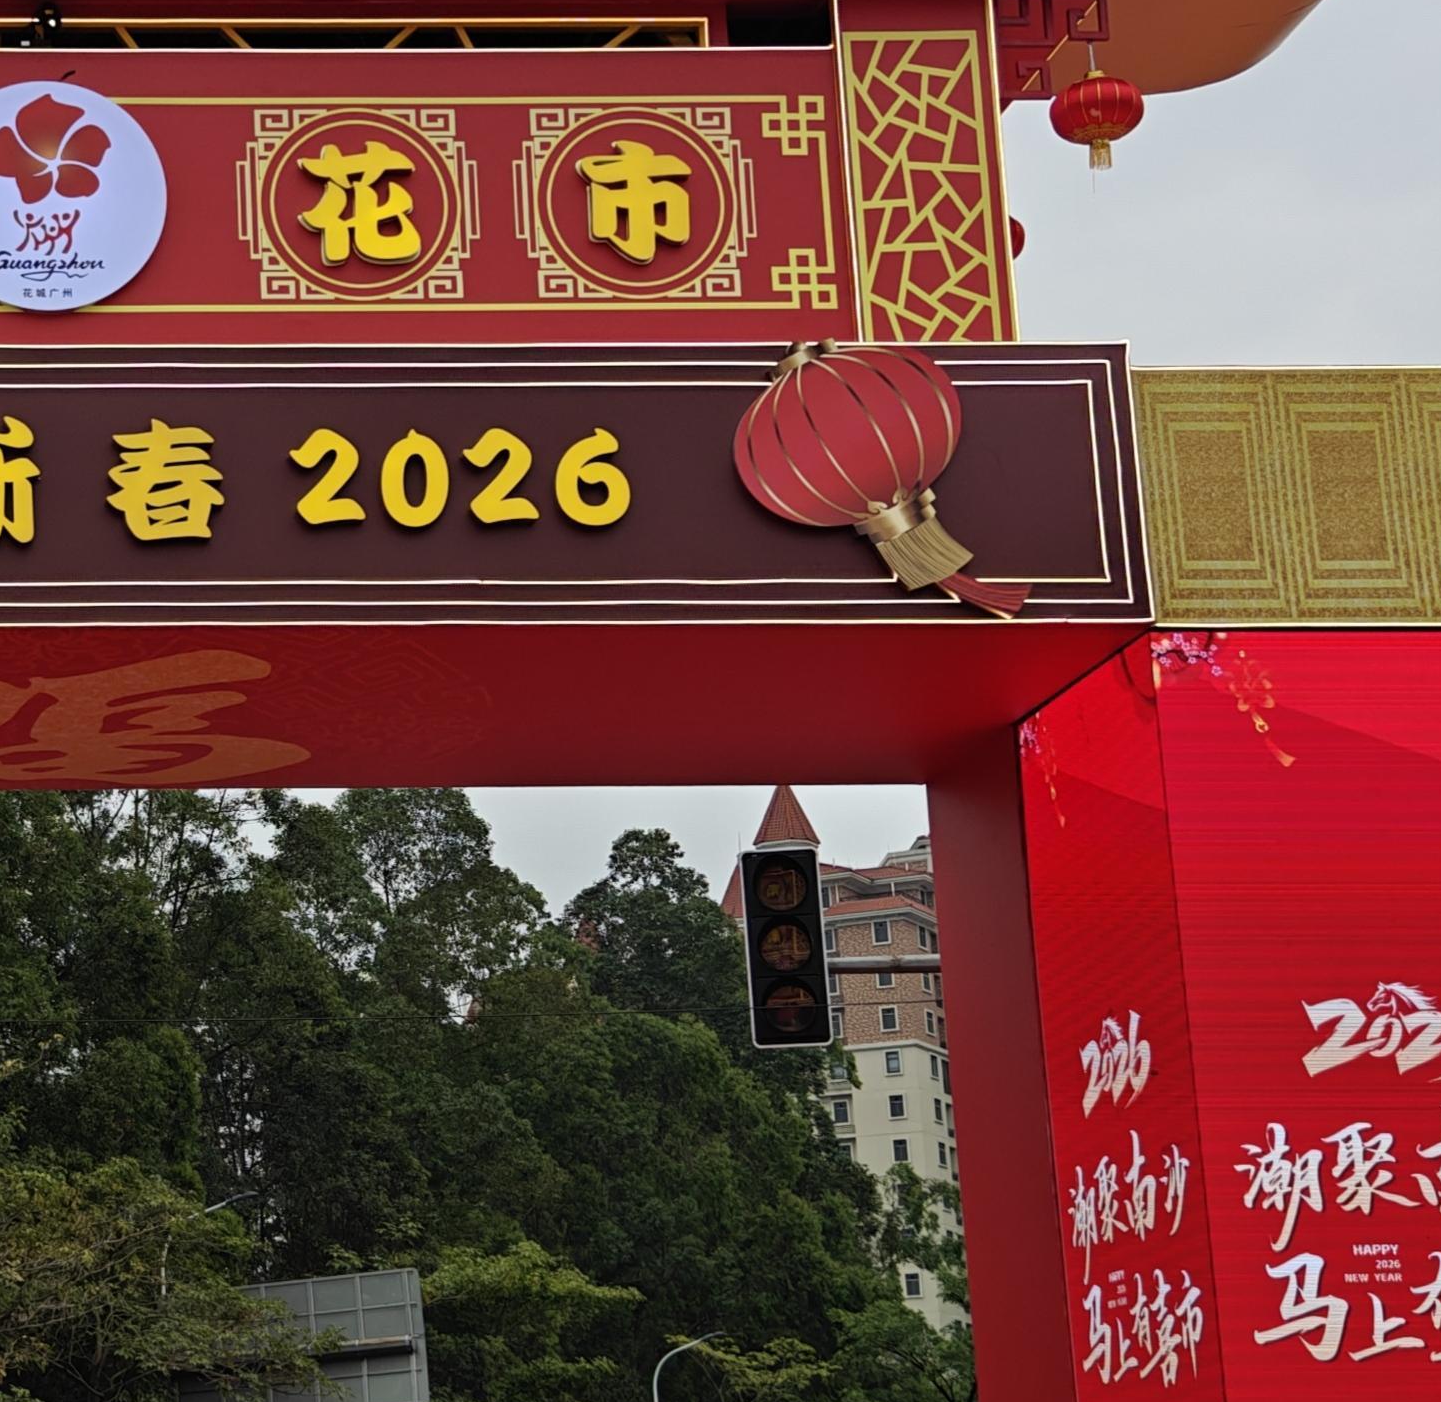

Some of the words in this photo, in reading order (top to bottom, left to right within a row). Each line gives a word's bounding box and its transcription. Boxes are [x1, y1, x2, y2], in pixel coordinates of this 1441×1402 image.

[22, 288, 73, 298] 花城广州
[290, 428, 631, 527] 2026
[1068, 1129, 1190, 1286] 潮聚南沙
[1352, 1243, 1399, 1256] HAPPY
[1374, 1259, 1401, 1270] 2026
[1344, 1273, 1369, 1283] NEW
[1374, 1272, 1402, 1282] YEAR
